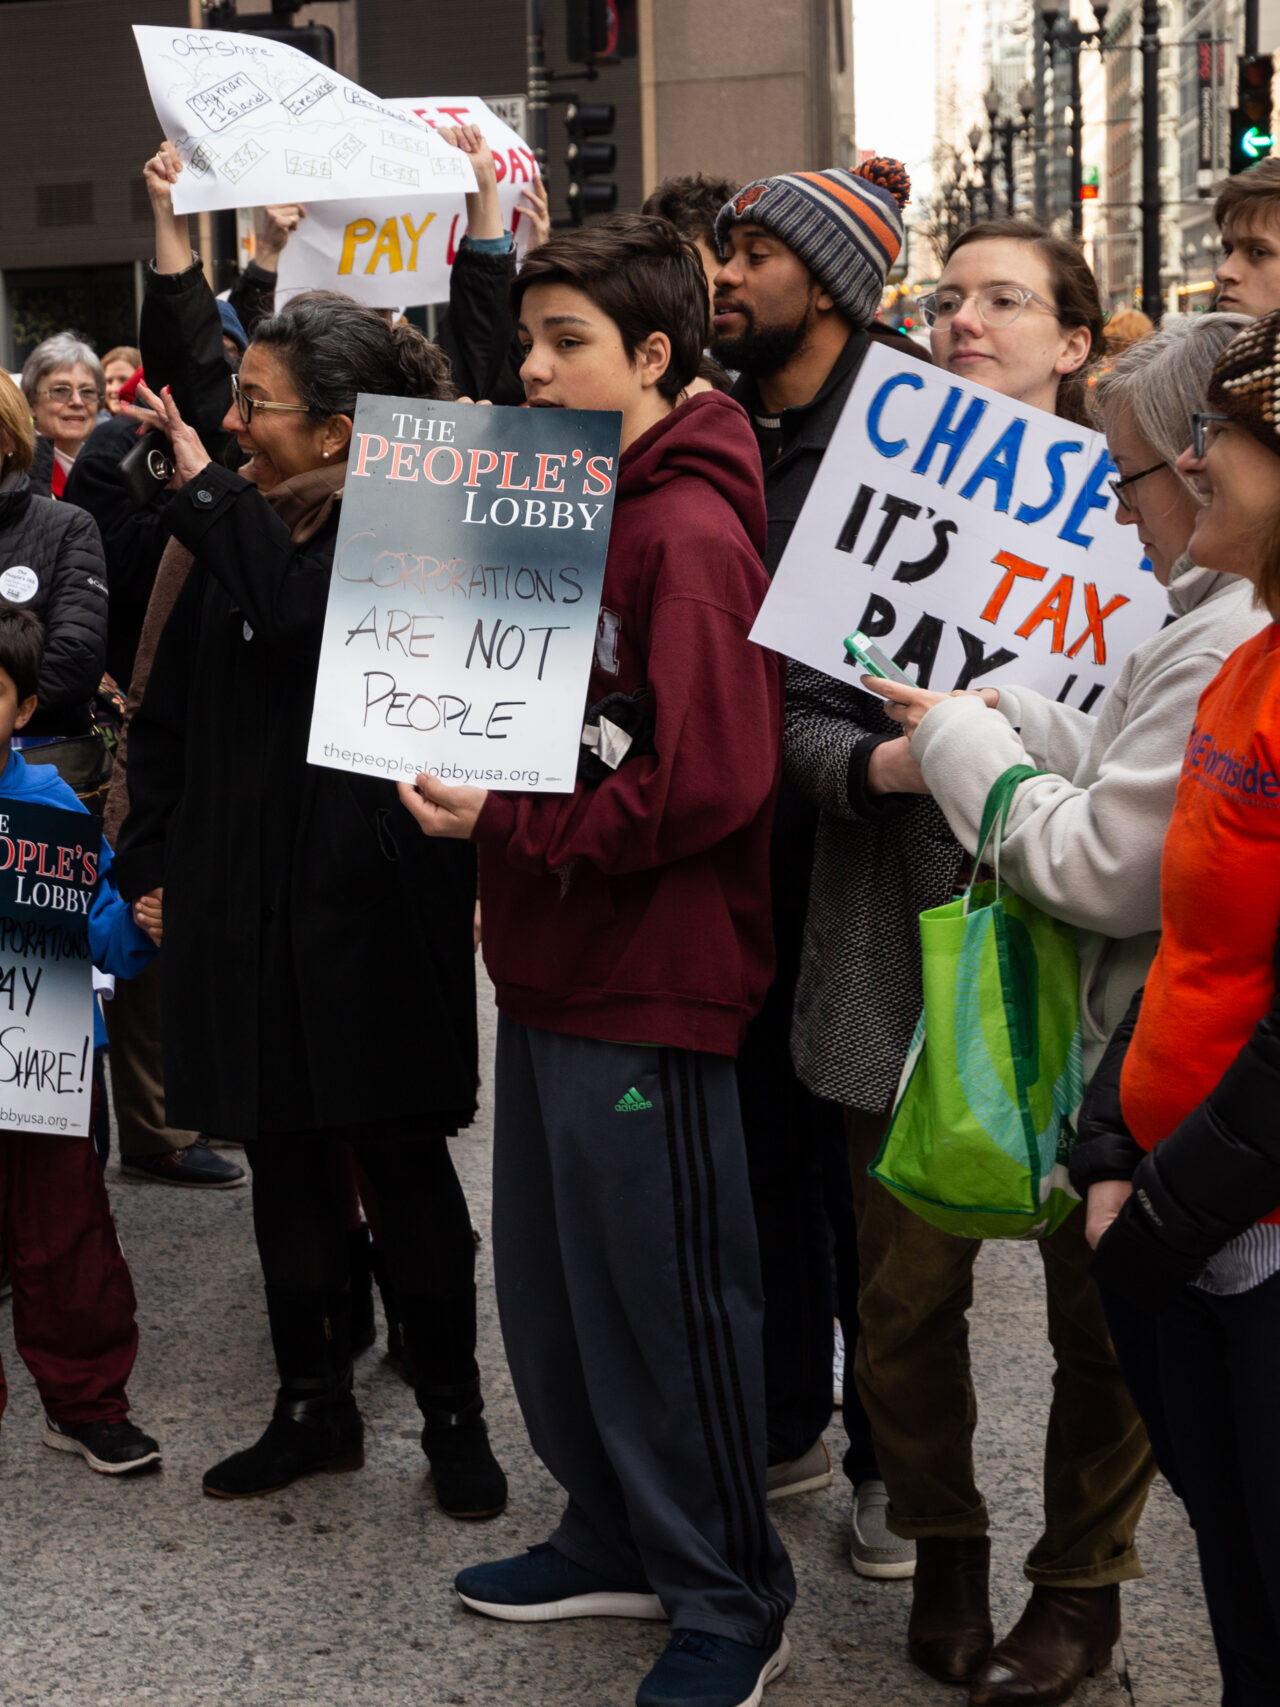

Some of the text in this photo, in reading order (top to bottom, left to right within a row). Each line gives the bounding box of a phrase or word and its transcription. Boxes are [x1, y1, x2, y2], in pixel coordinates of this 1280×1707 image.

[338, 213, 436, 275] PAY
[392, 413, 456, 443] THE
[351, 432, 614, 496] PEOPLE'S
[462, 491, 604, 531] LOBBY
[336, 532, 584, 604] CORPORATIONS
[834, 483, 1131, 665] IT'S TAX
[345, 606, 570, 681] ARE NOT
[363, 671, 526, 739] PEOPLE
[323, 743, 540, 785] thepeopleslobbyusa.org
[15, 876, 92, 916] LOBBY
[615, 1101, 653, 1112] adidas
